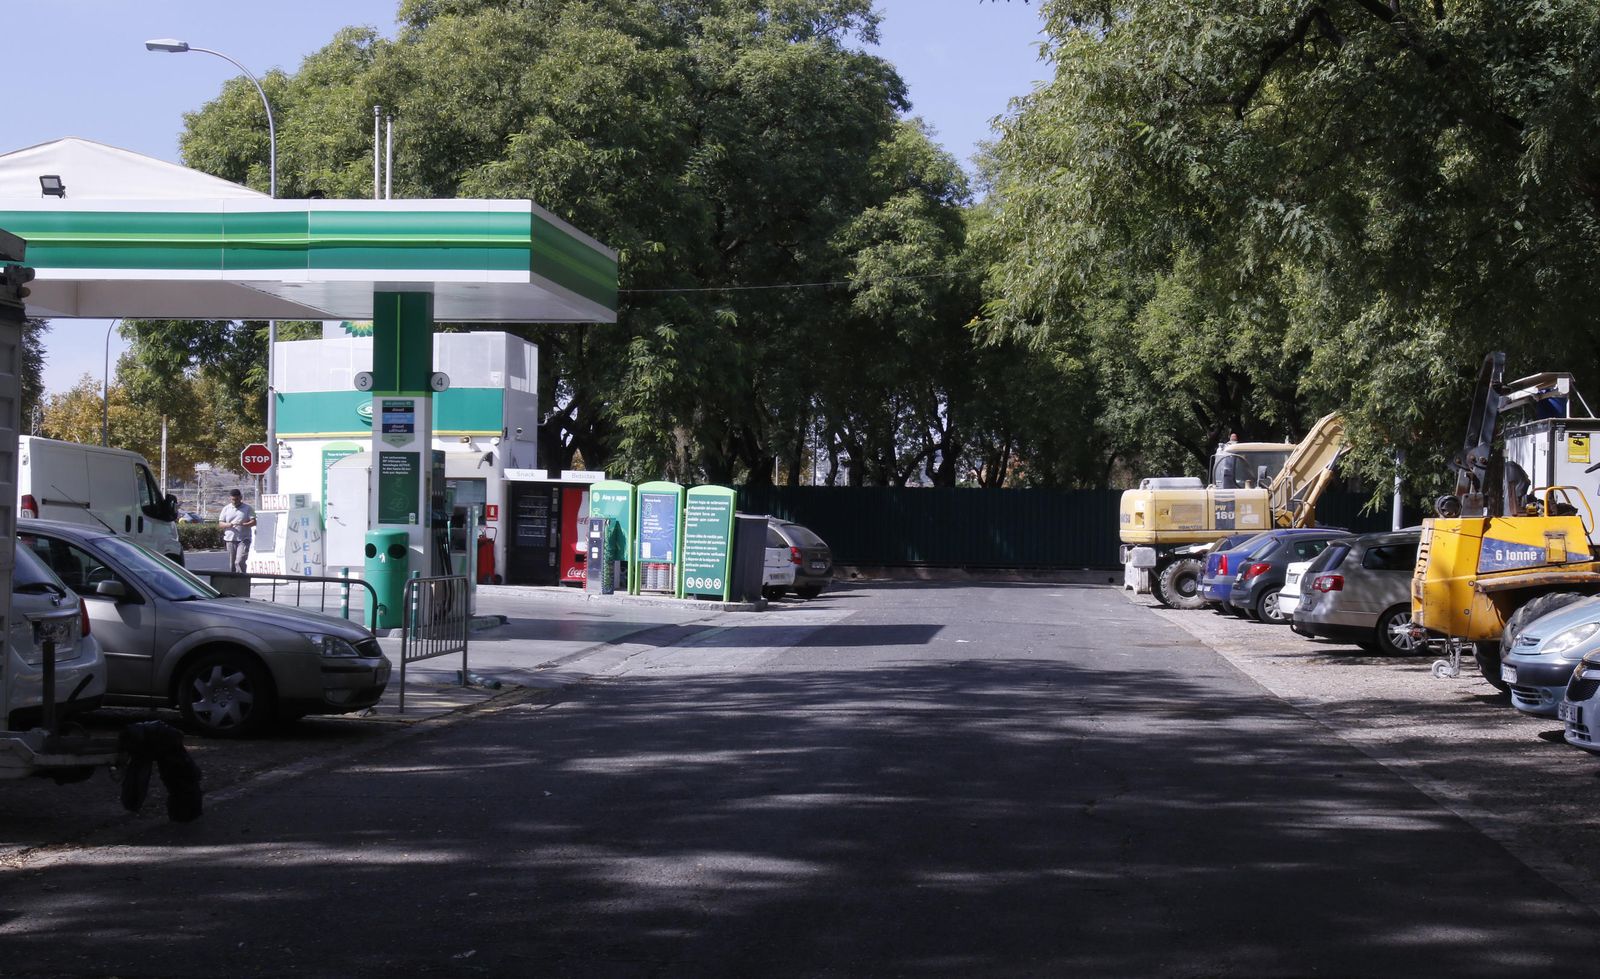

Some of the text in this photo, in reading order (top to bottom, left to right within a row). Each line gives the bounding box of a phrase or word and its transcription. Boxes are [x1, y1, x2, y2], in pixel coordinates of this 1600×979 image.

[360, 376, 368, 387] 3
[436, 377, 444, 387] 4
[244, 455, 270, 464] STOP
[262, 495, 288, 510] HIELO
[1496, 550, 1502, 560] 6
[250, 561, 282, 575] ALBAIDA
